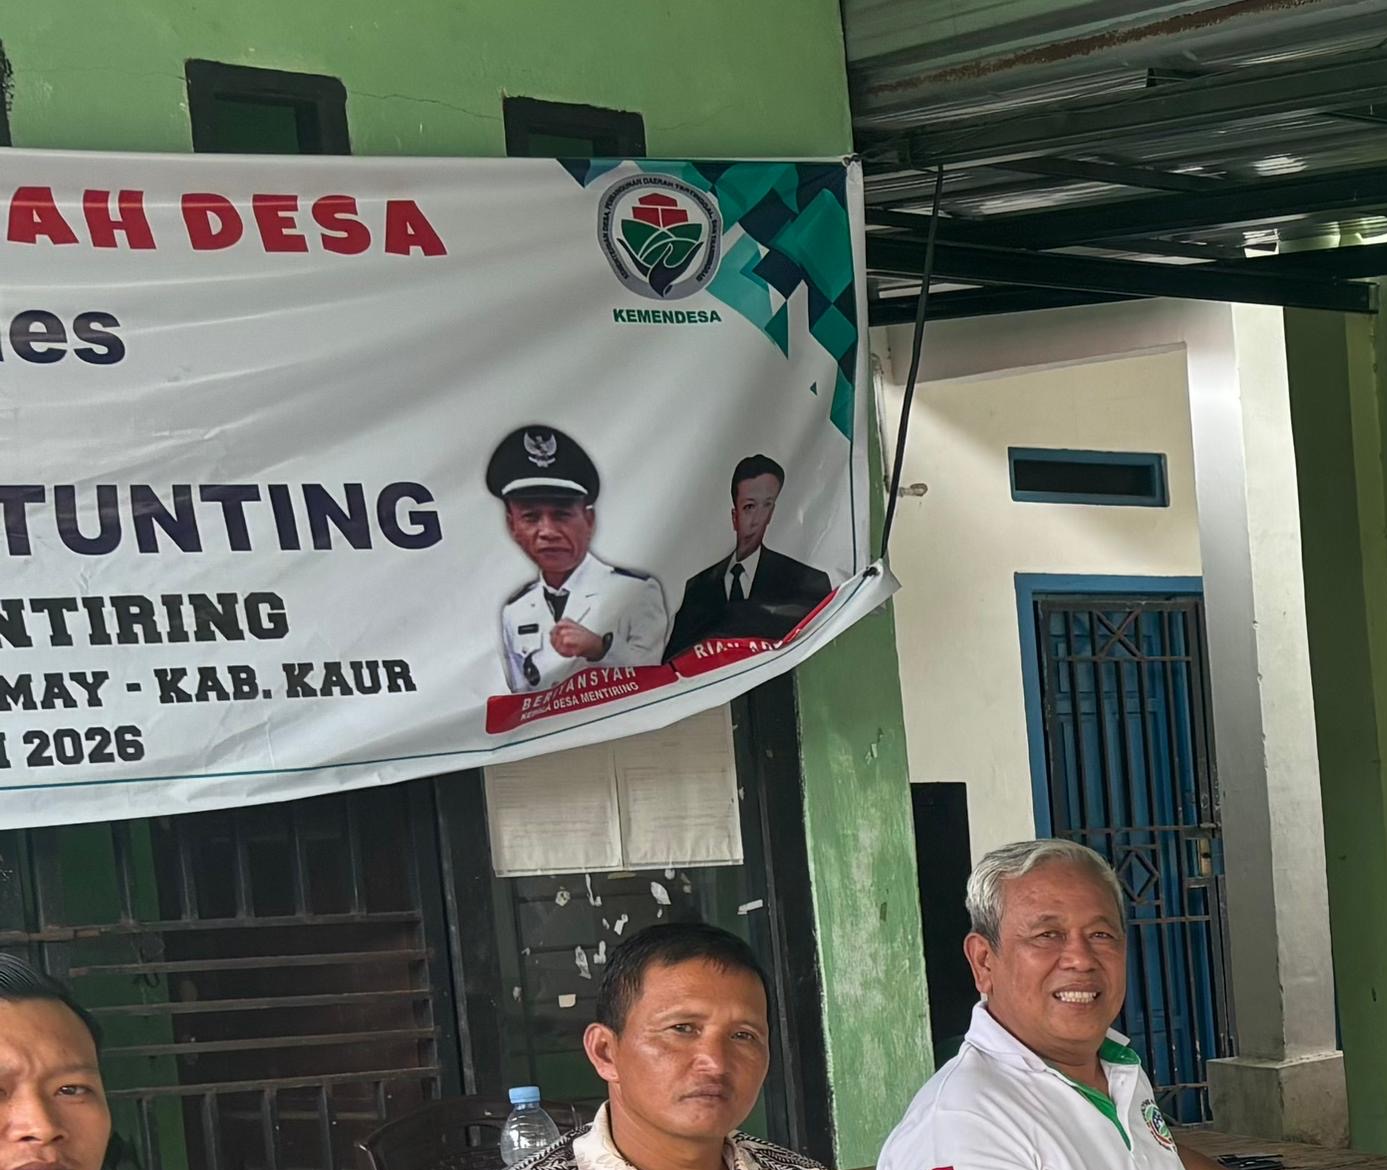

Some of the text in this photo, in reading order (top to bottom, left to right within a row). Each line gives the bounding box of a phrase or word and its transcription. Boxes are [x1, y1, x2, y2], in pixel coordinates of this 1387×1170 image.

[7, 186, 448, 257] AH DESA
[0, 309, 126, 365] es
[613, 308, 722, 324] KEMENDESA
[0, 481, 444, 557] TUNTING
[153, 664, 273, 704] KAB.
[281, 659, 418, 698] KAUR
[553, 681, 639, 710] DESA MENTIRING
[22, 725, 146, 768] 2026
